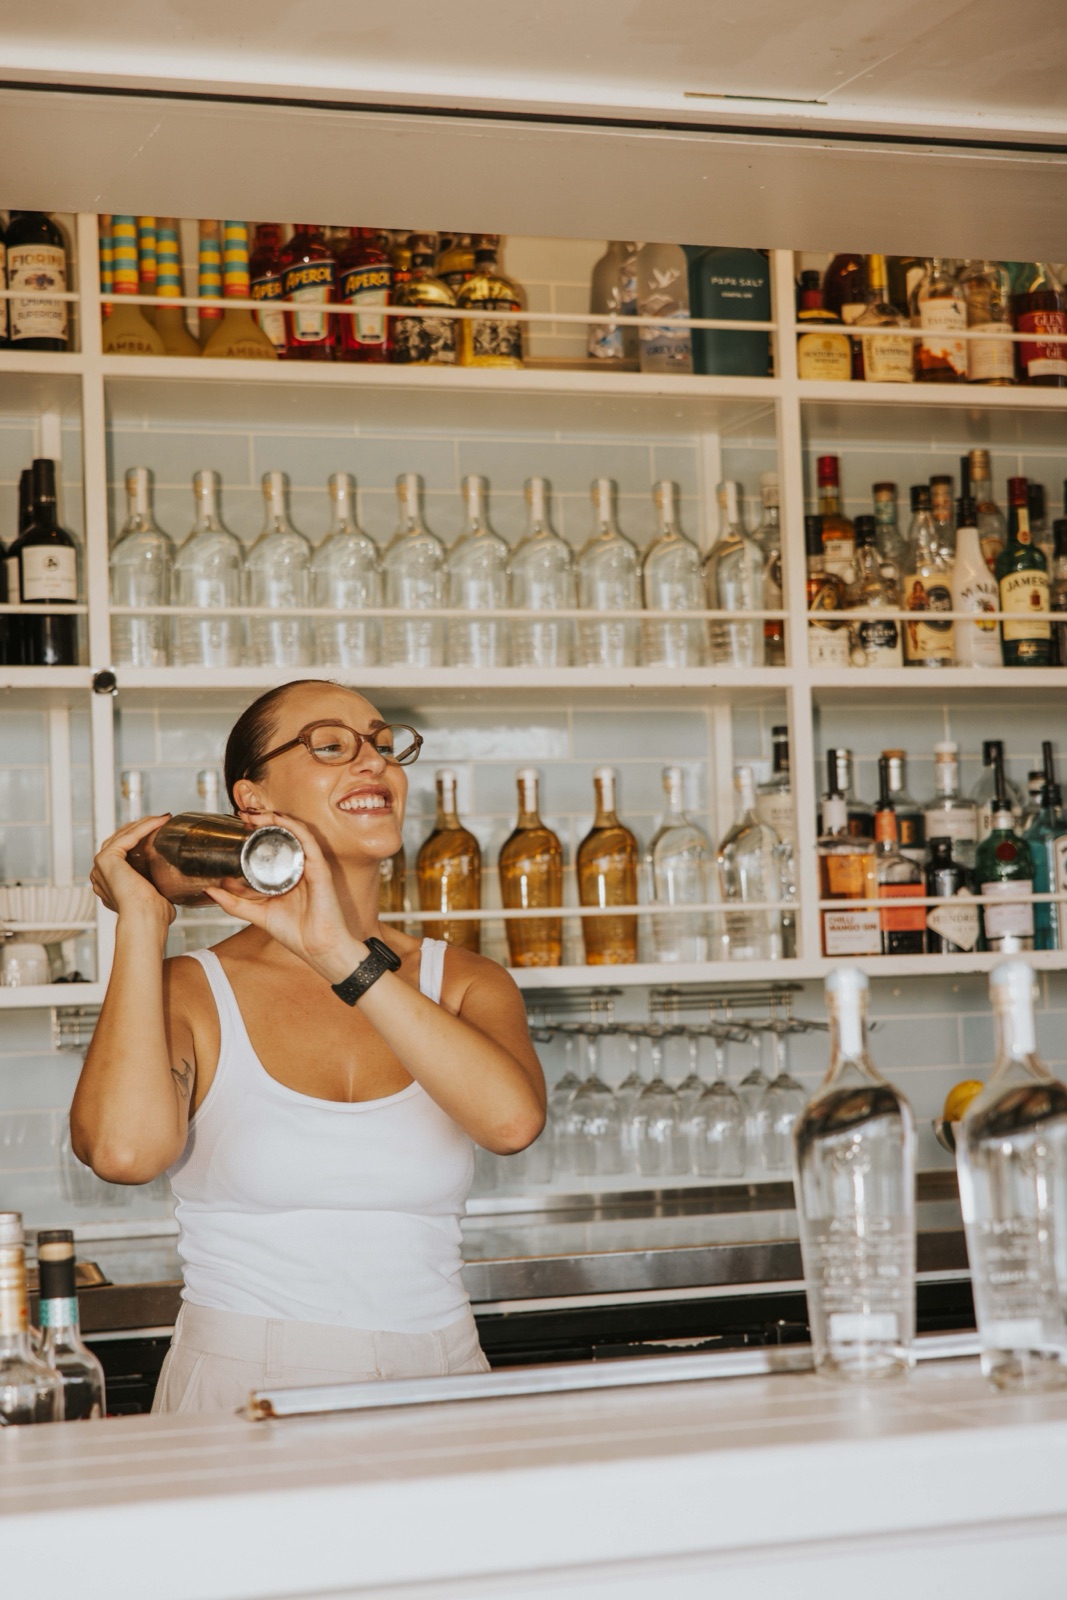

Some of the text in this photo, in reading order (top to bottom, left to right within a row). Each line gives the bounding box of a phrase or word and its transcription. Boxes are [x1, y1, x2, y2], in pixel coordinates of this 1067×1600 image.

[286, 266, 332, 291] APEROL
[345, 271, 391, 294] APEROL
[710, 276, 764, 288] PAPA SALT
[1034, 313, 1063, 328] GLEN
[106, 341, 154, 353] AMBRA
[828, 922, 877, 932] MANGO GIN
